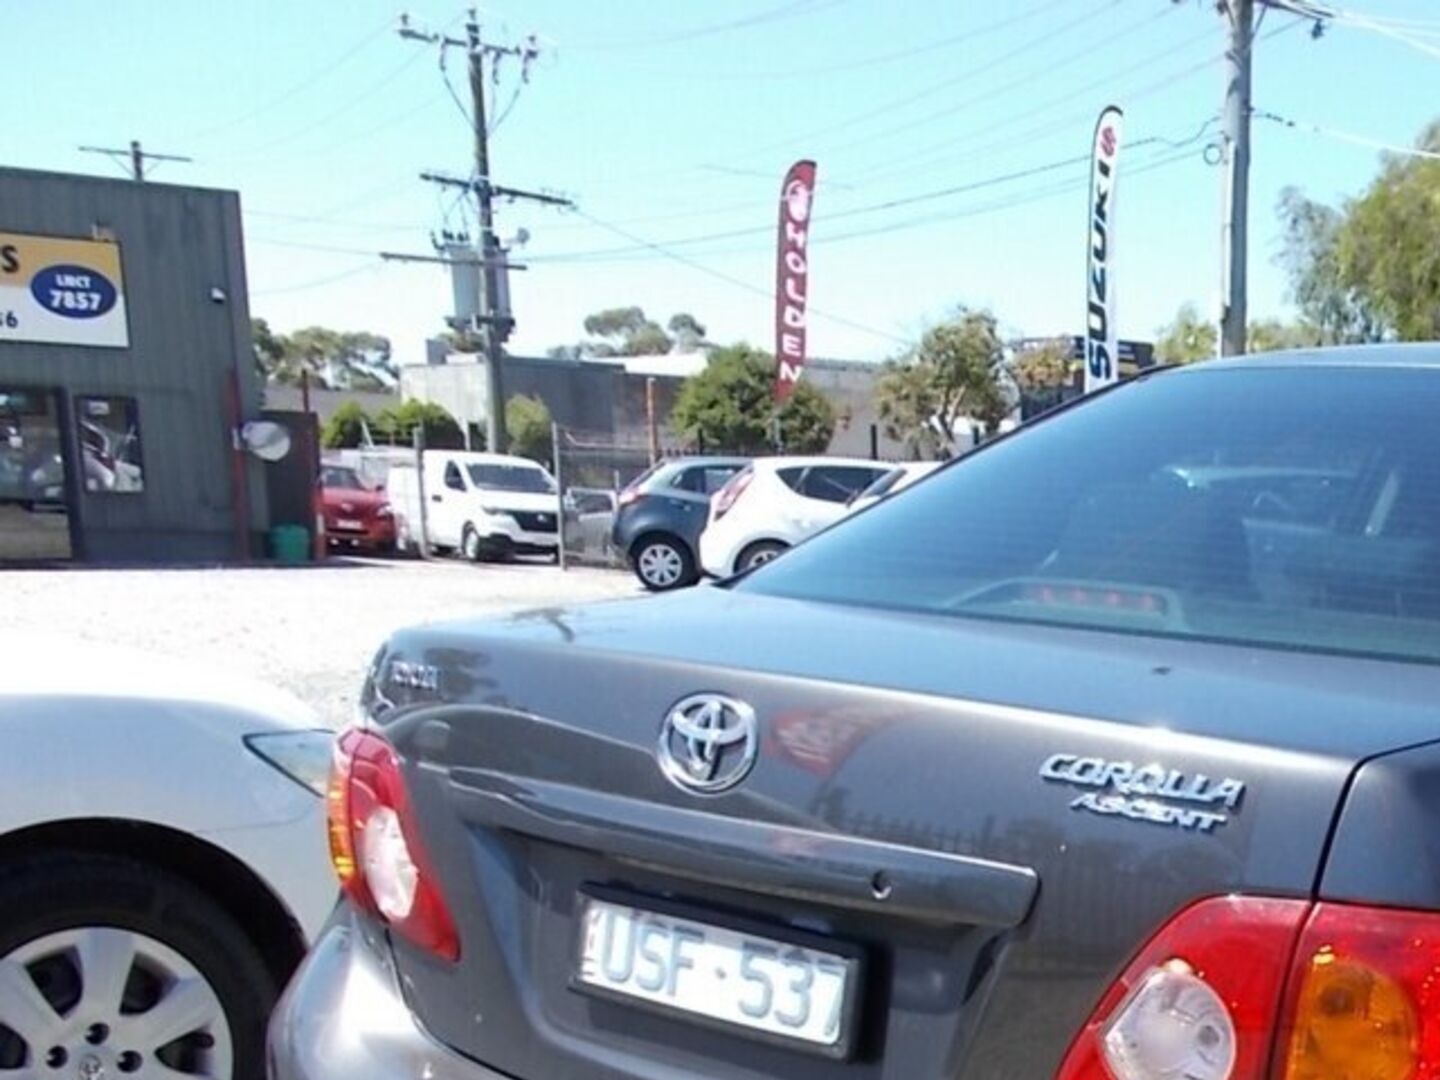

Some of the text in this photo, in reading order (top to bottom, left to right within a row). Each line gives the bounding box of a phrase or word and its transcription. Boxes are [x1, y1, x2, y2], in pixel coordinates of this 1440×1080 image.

[1088, 159, 1112, 380] SUZUKI
[48, 289, 102, 311] 7857
[779, 221, 806, 382] HOLDEN
[1038, 753, 1246, 808] COROLLA
[1069, 793, 1227, 830] ASCENT
